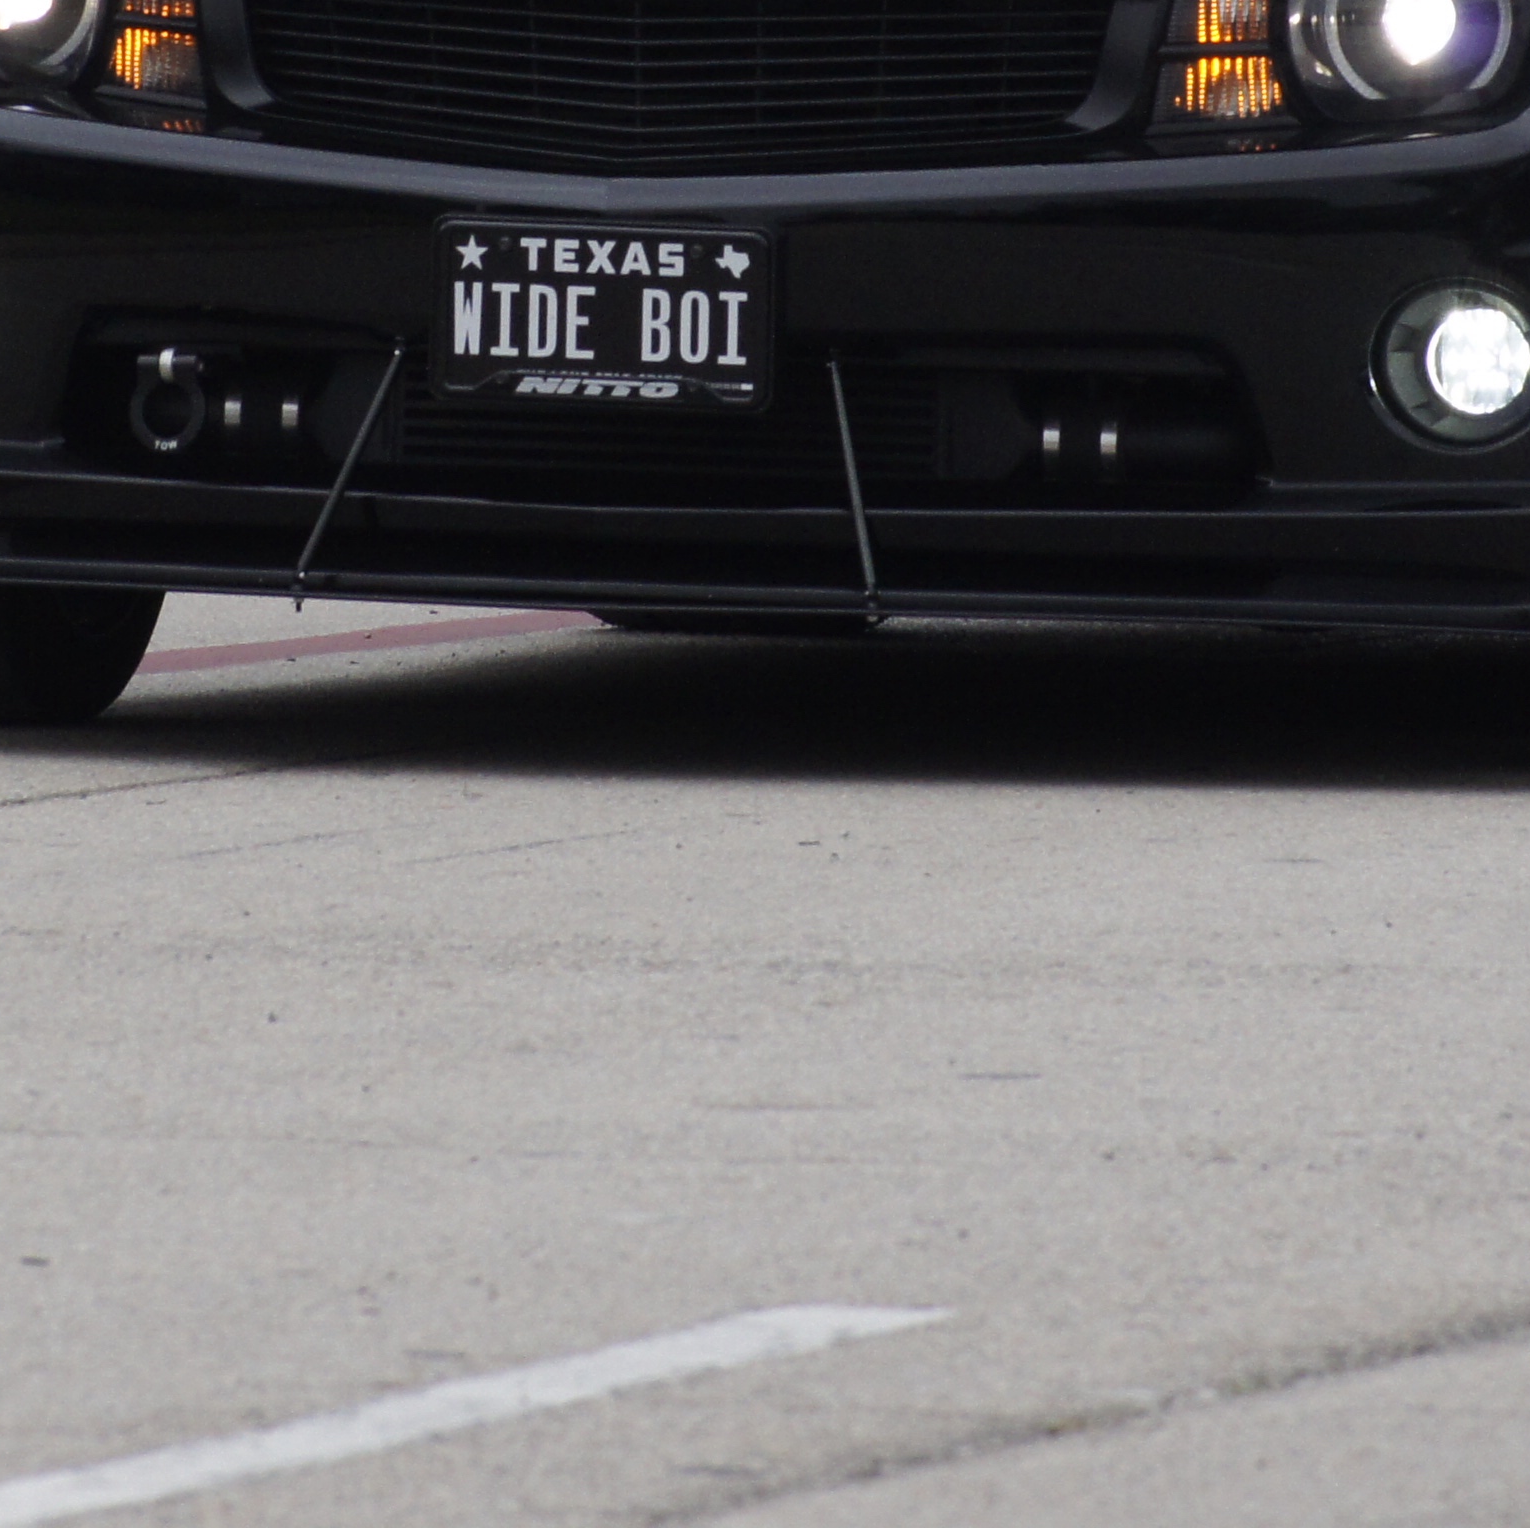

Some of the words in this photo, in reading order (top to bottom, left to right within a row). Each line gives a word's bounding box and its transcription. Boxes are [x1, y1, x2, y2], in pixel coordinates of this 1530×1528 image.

[520, 237, 684, 277] TEXAS
[453, 281, 596, 360] WIDE
[641, 287, 748, 366] BOI
[516, 376, 679, 399] NITTO
[154, 439, 178, 451] TOW
